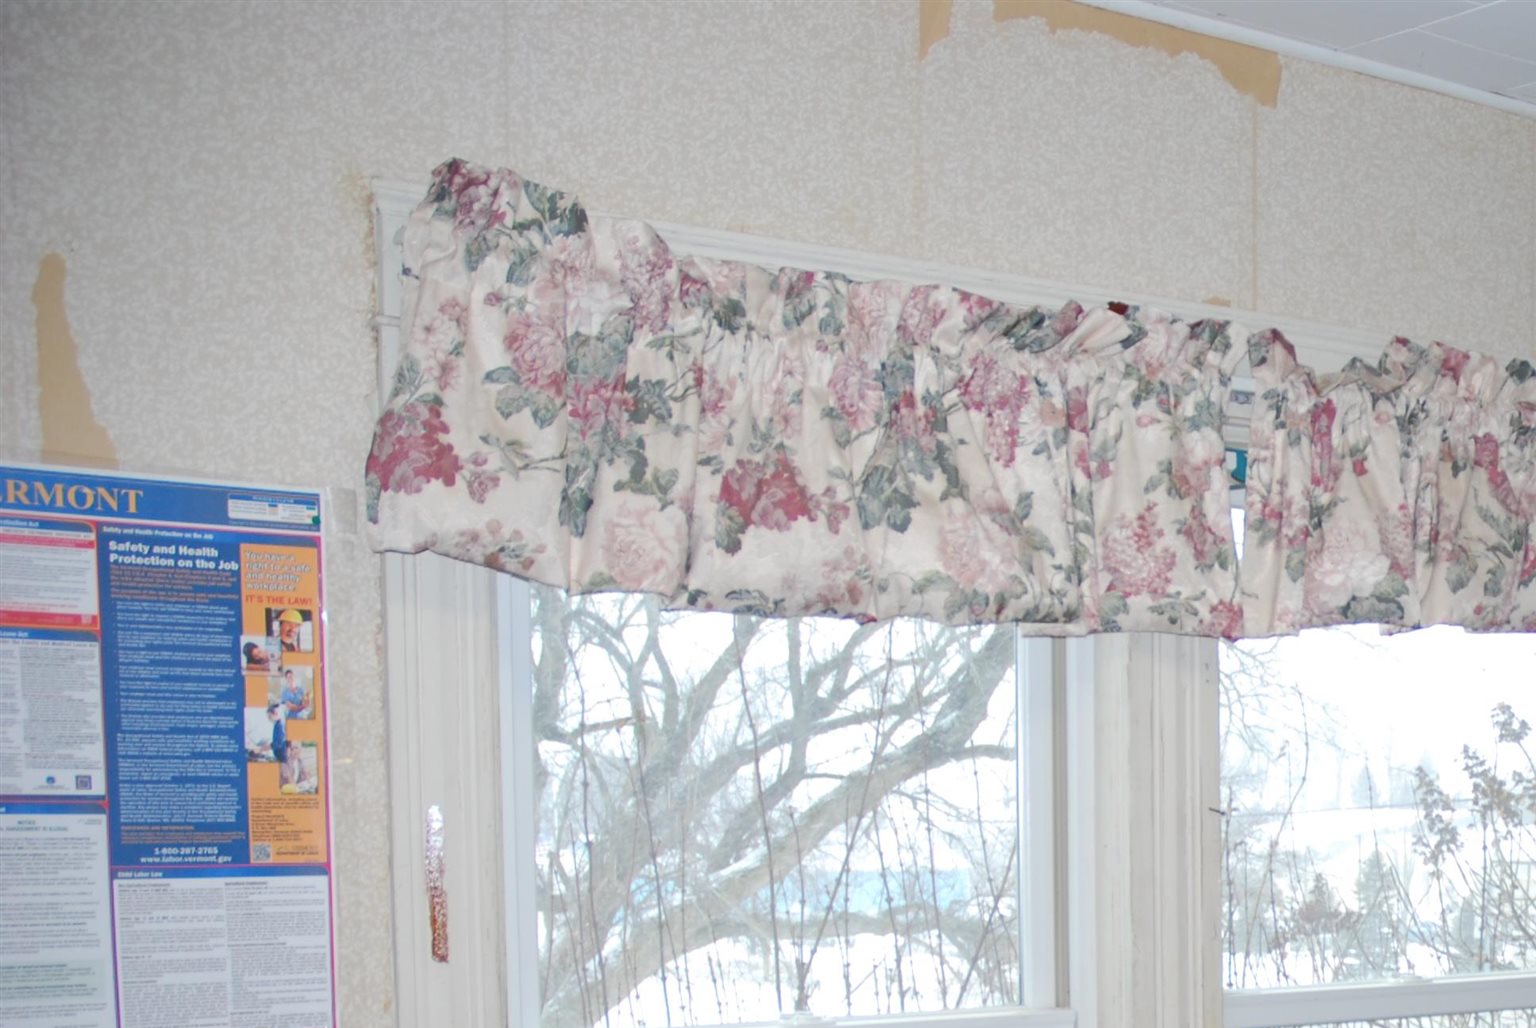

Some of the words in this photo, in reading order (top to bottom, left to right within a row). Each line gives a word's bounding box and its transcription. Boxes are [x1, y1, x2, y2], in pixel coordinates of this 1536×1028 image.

[0, 479, 143, 513] RMONT
[109, 541, 150, 554] Safety
[153, 544, 175, 555] and
[178, 545, 218, 557] Health
[109, 553, 175, 567] Protection
[178, 557, 193, 568] on
[196, 558, 216, 569] the
[218, 560, 239, 571] Job
[267, 596, 285, 605] THE
